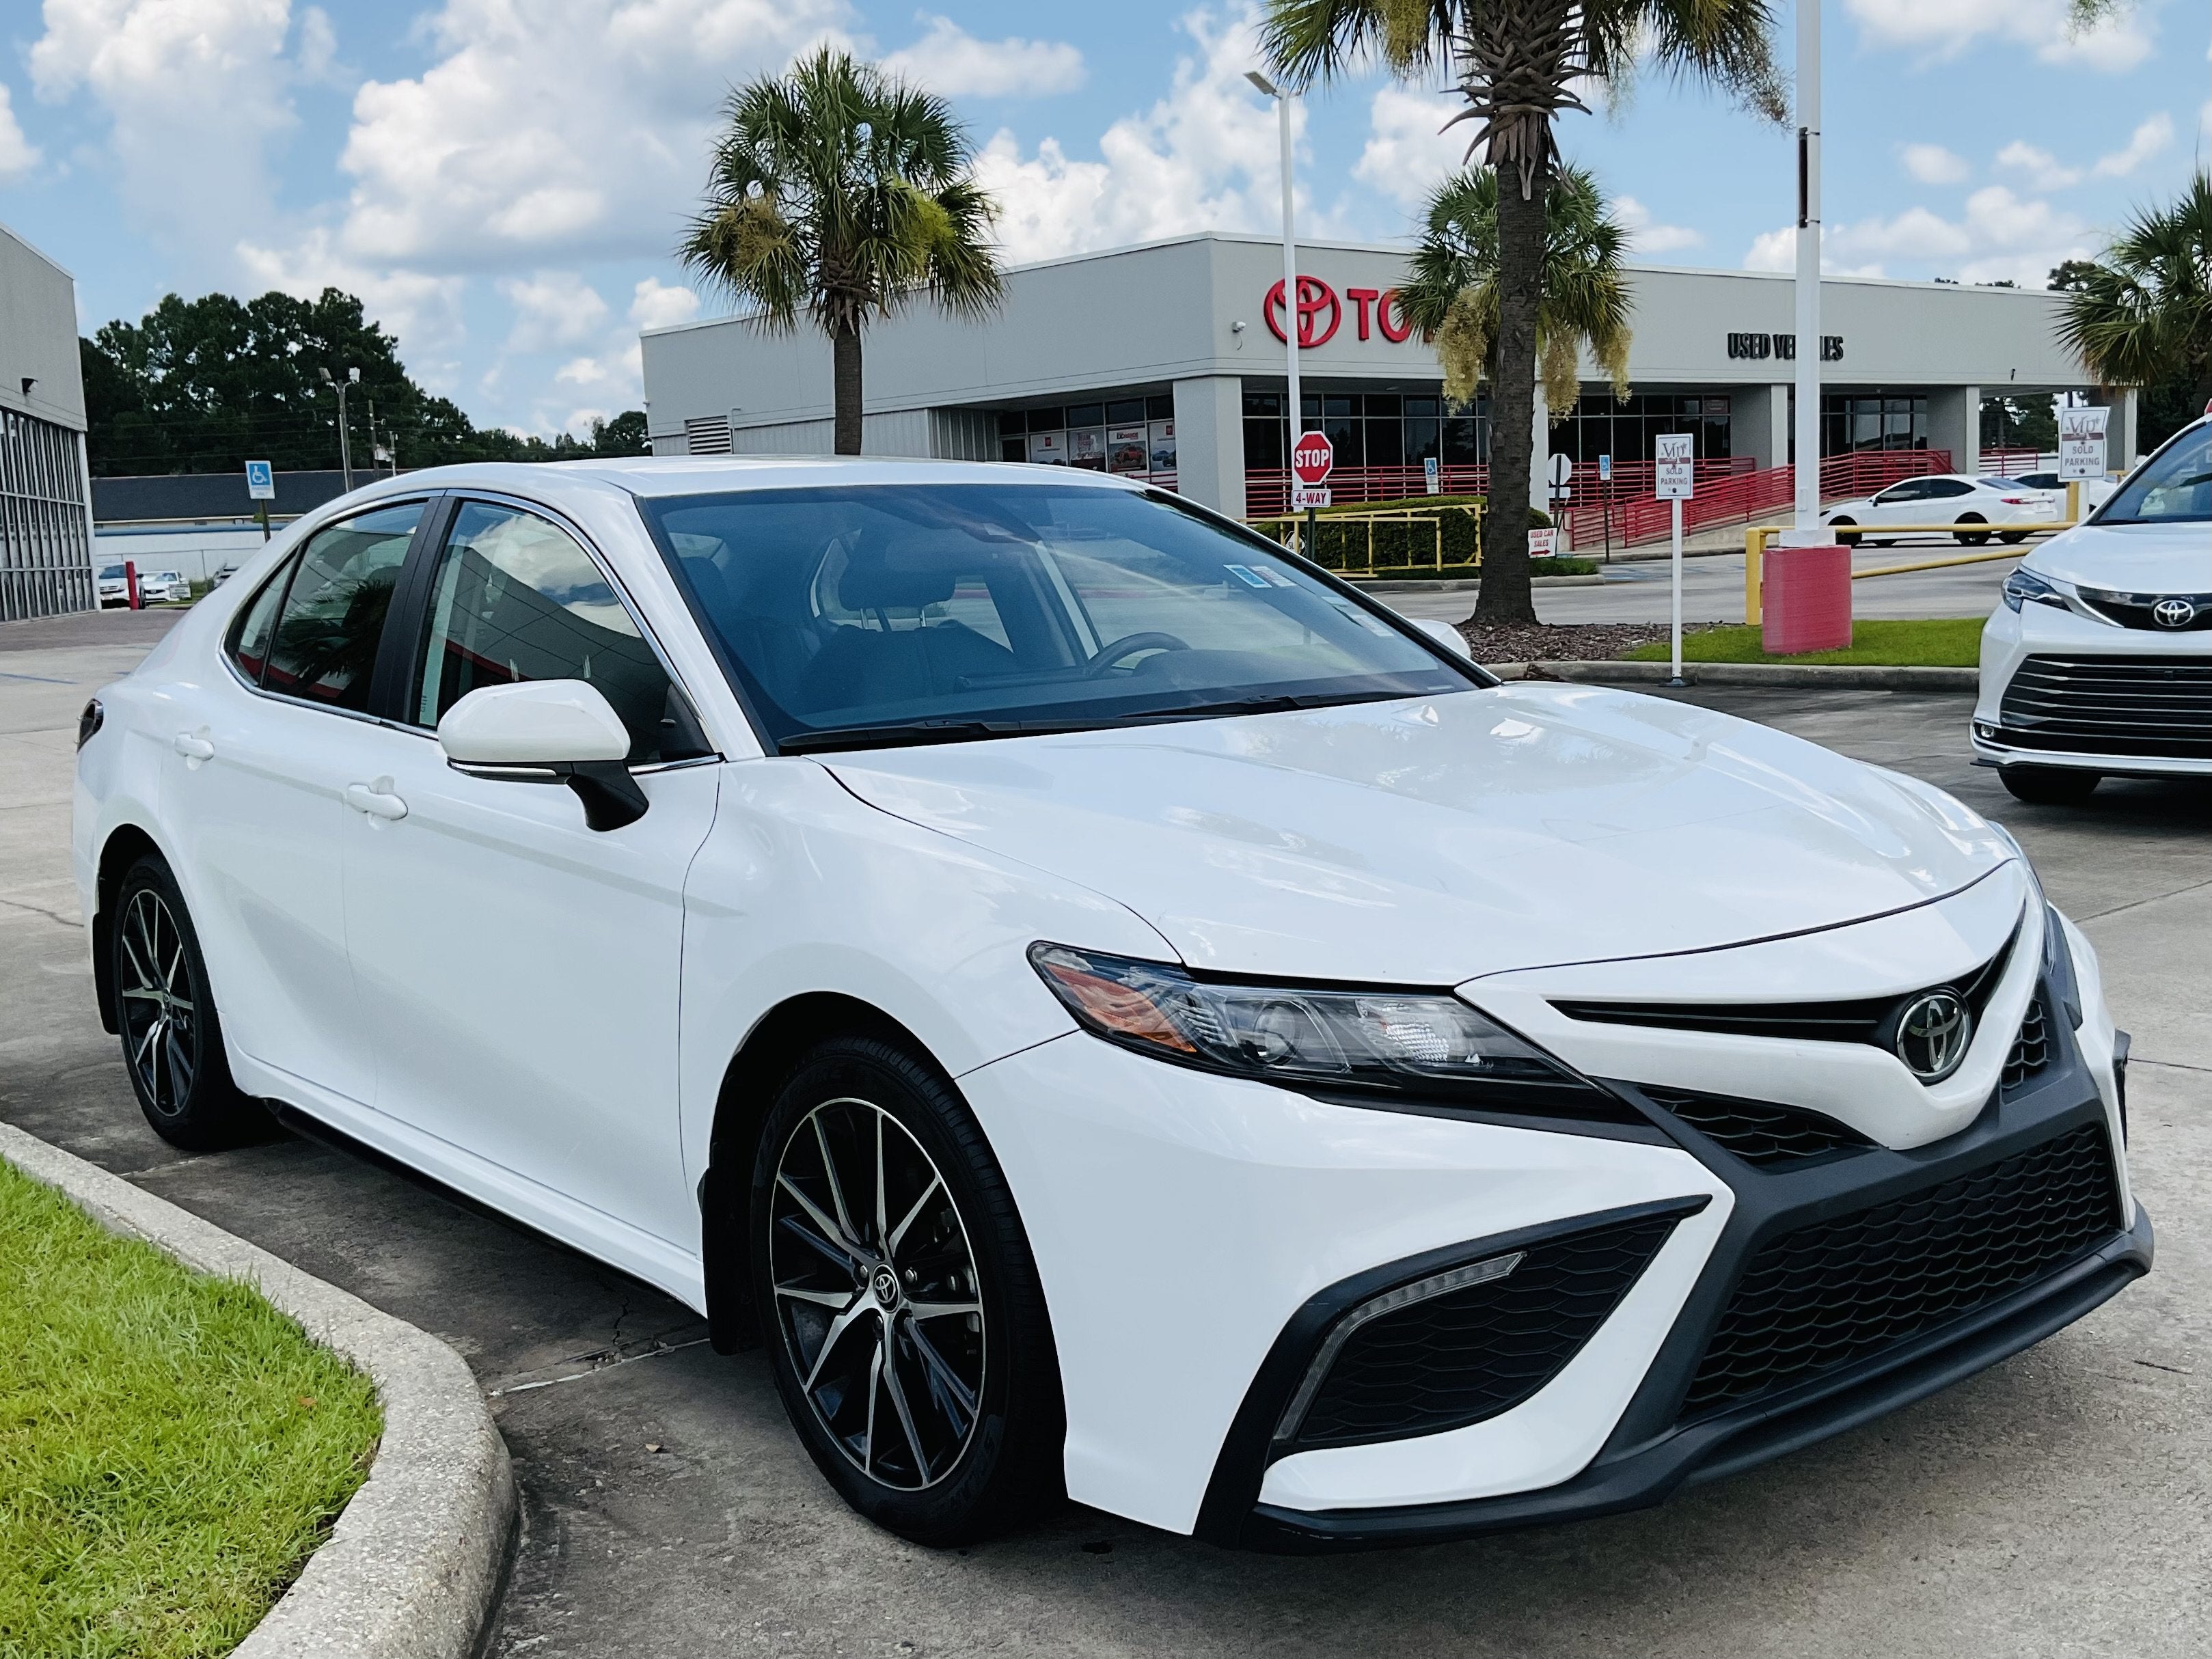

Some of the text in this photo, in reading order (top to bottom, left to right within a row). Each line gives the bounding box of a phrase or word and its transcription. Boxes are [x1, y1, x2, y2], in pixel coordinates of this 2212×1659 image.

[1728, 332, 1844, 361] USED VELES
[2073, 446, 2093, 454] SOLD
[1295, 448, 1330, 468] STOP
[2064, 457, 2100, 466] PARKING
[1296, 492, 1326, 504] 4-WAY
[1531, 529, 1554, 538] USED CAR
[1534, 539, 1548, 547] SALES
